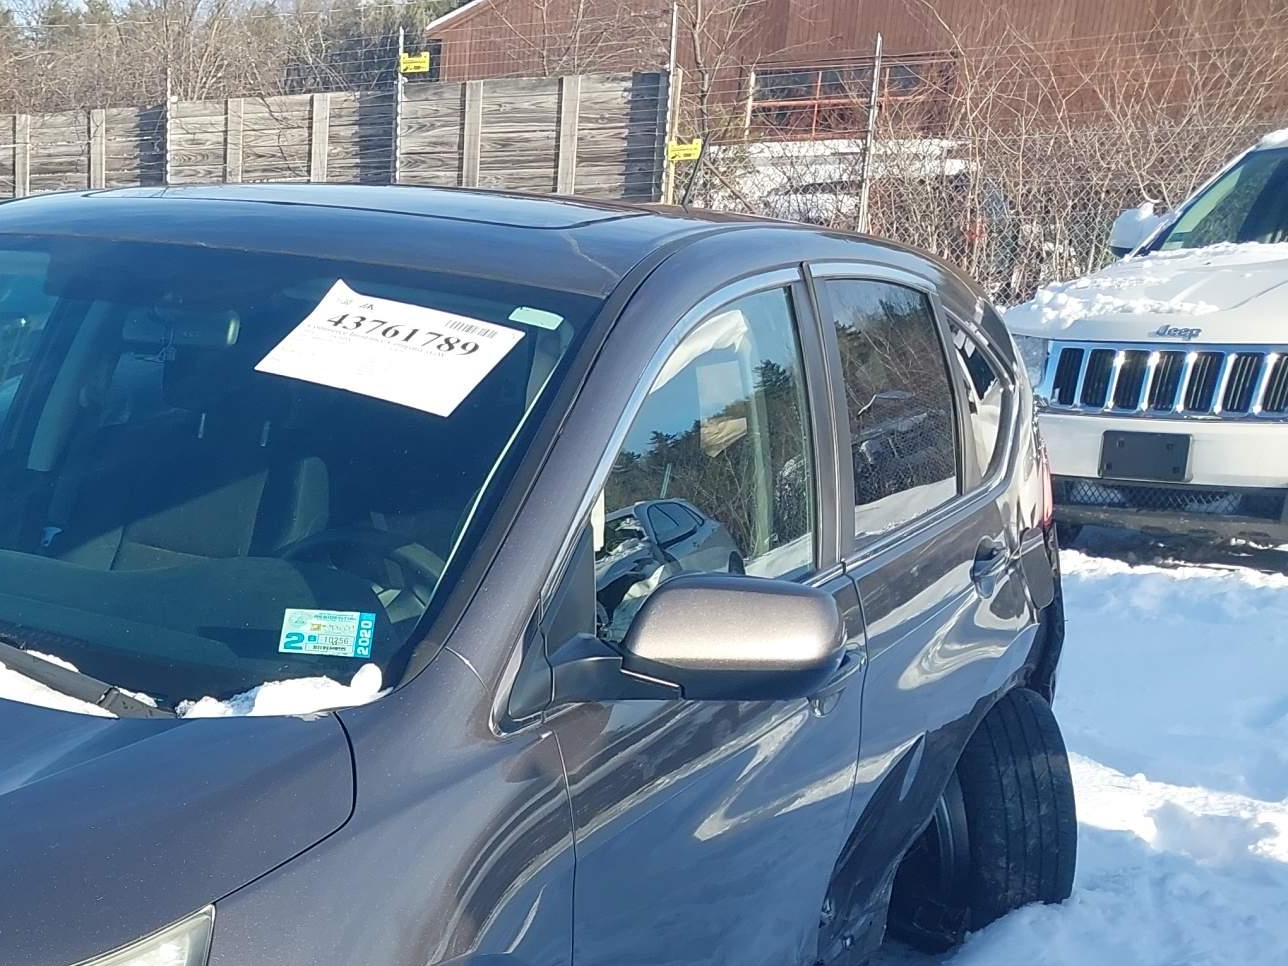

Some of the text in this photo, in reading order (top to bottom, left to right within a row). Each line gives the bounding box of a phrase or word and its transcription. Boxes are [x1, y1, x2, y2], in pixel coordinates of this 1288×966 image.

[326, 313, 480, 356] 43761789
[1156, 324, 1202, 340] Jeep
[283, 632, 305, 650] 2
[356, 620, 373, 656] 2020
